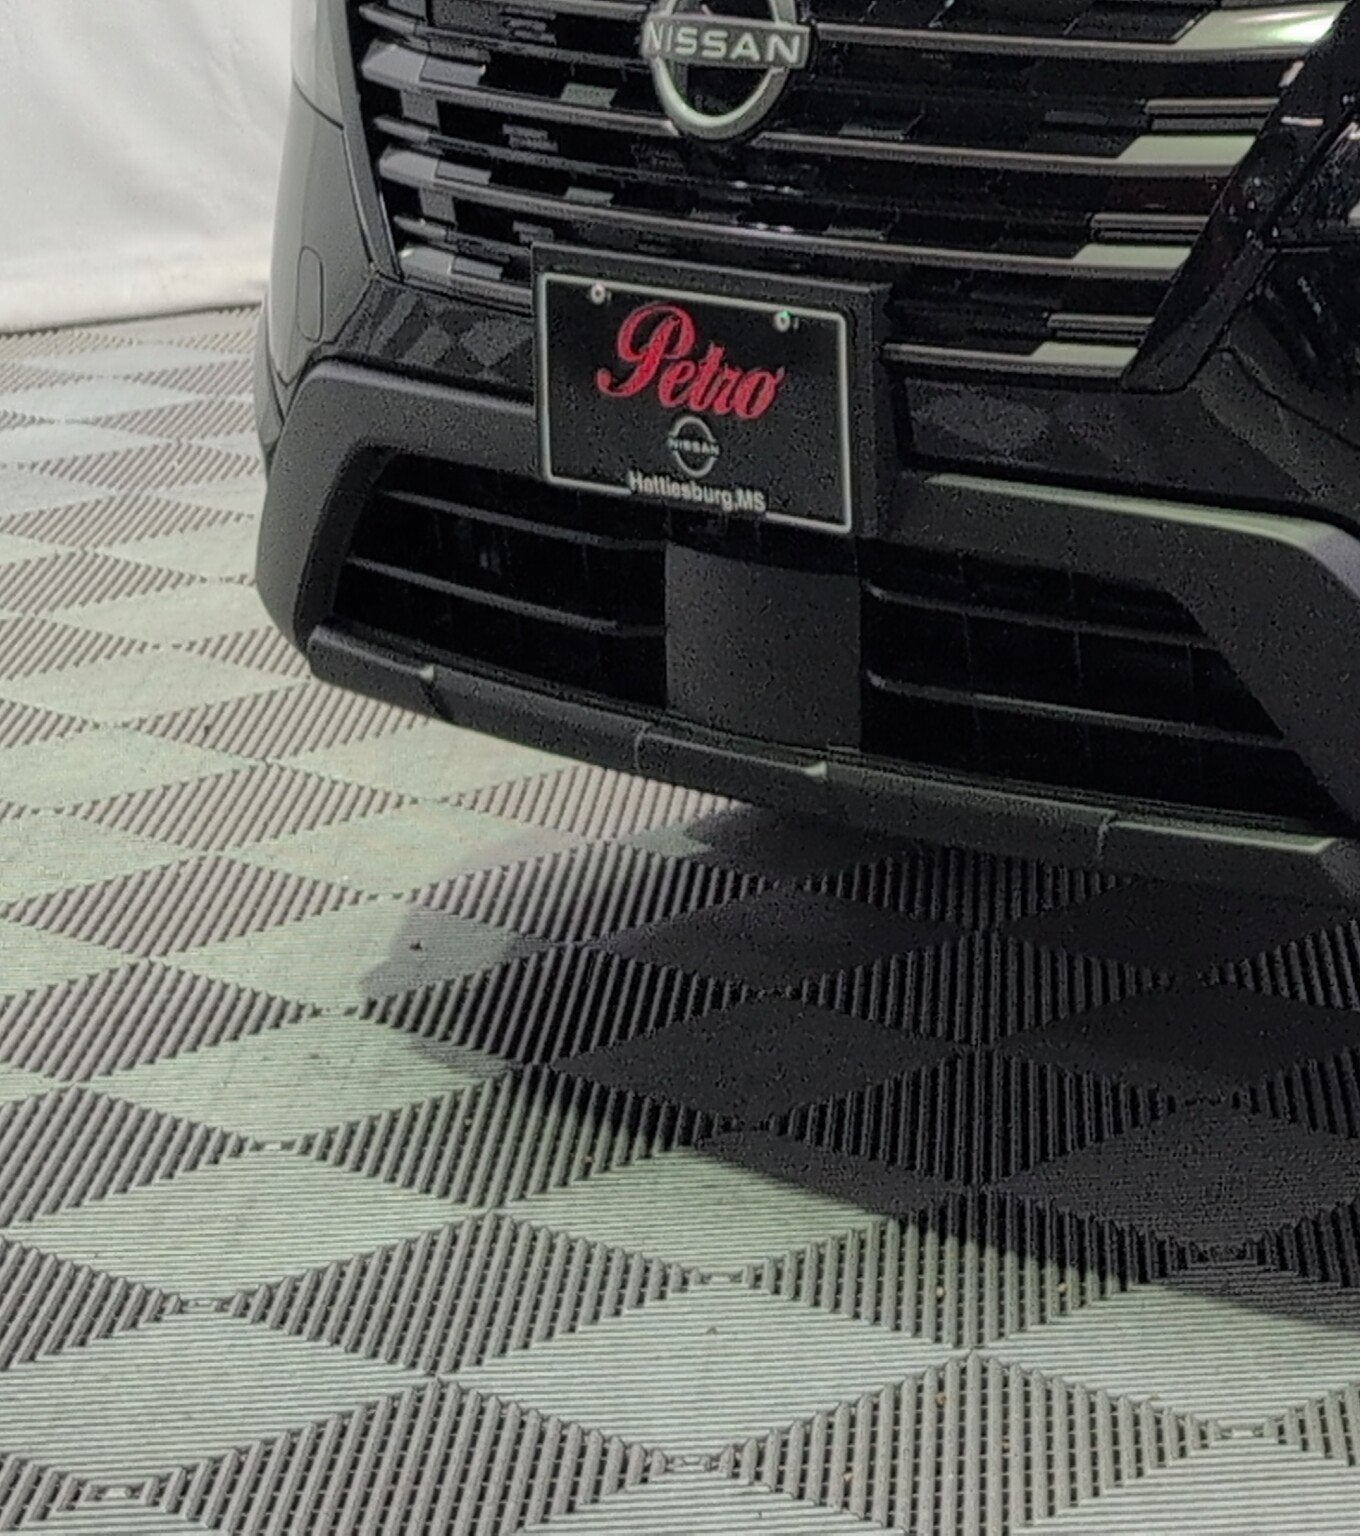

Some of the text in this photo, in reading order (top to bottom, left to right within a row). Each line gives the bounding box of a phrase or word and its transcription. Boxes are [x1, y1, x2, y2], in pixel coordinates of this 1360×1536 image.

[645, 20, 801, 64] NISSAN
[597, 301, 786, 421] Petro
[667, 436, 721, 456] NISSAN
